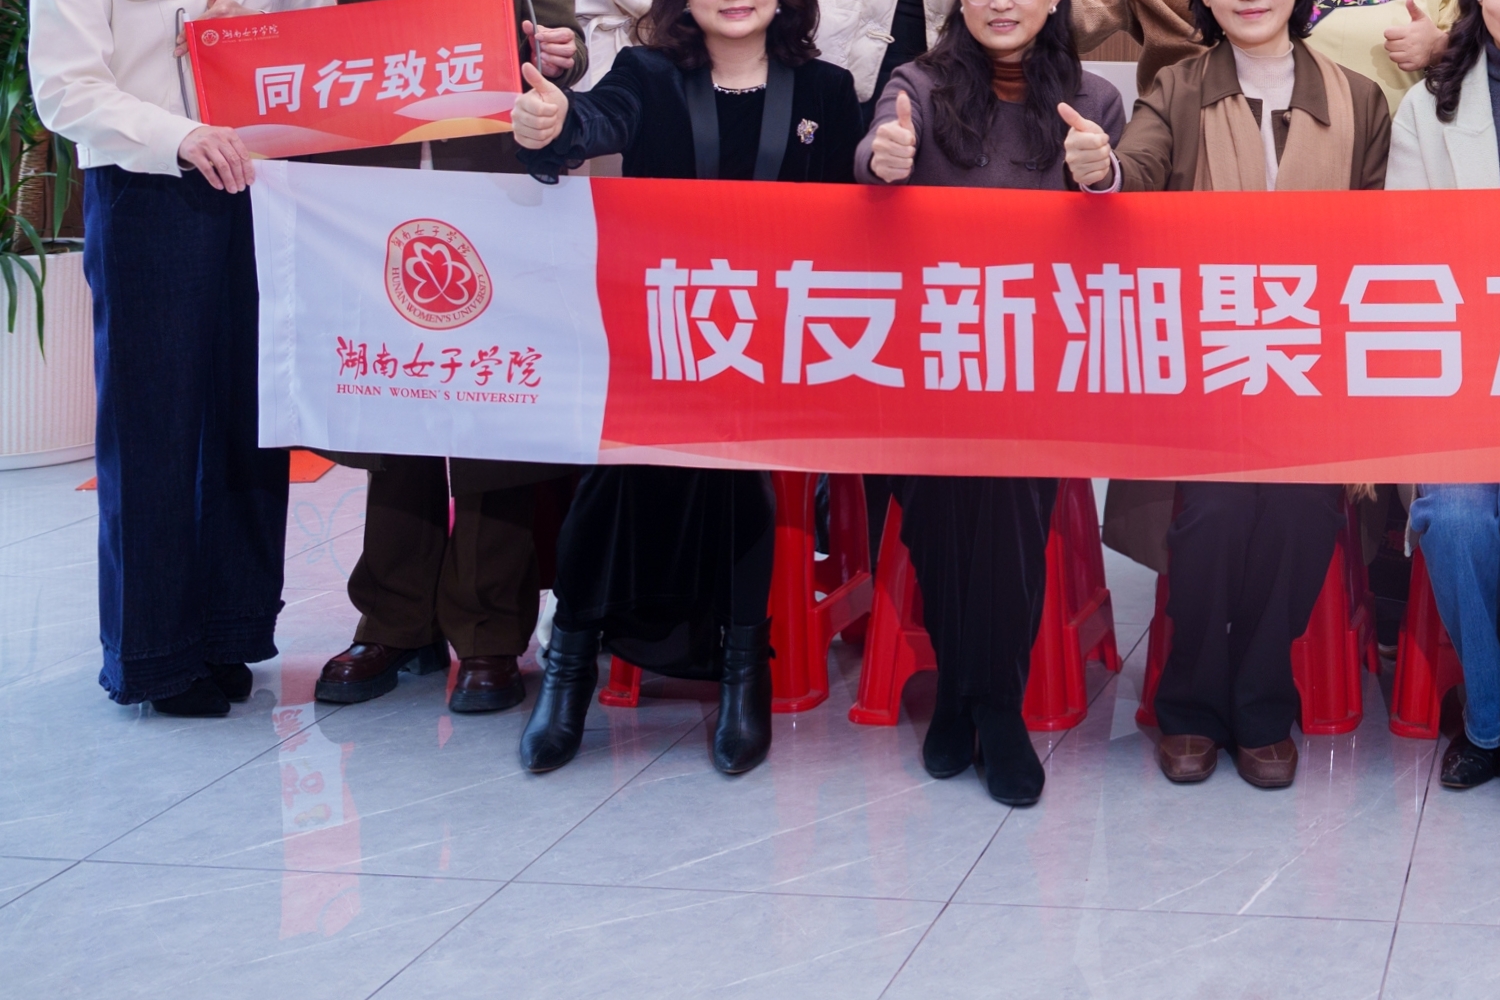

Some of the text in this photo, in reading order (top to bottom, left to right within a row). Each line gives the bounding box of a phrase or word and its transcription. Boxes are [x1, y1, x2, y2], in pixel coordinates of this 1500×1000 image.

[254, 43, 484, 116] 同行致远
[391, 267, 406, 305] HUNAN
[453, 271, 487, 320] UNIVERSITY
[336, 335, 543, 388] 湖南女子学院
[336, 384, 382, 396] HUNAN
[456, 391, 539, 404] UNIVERSITY
